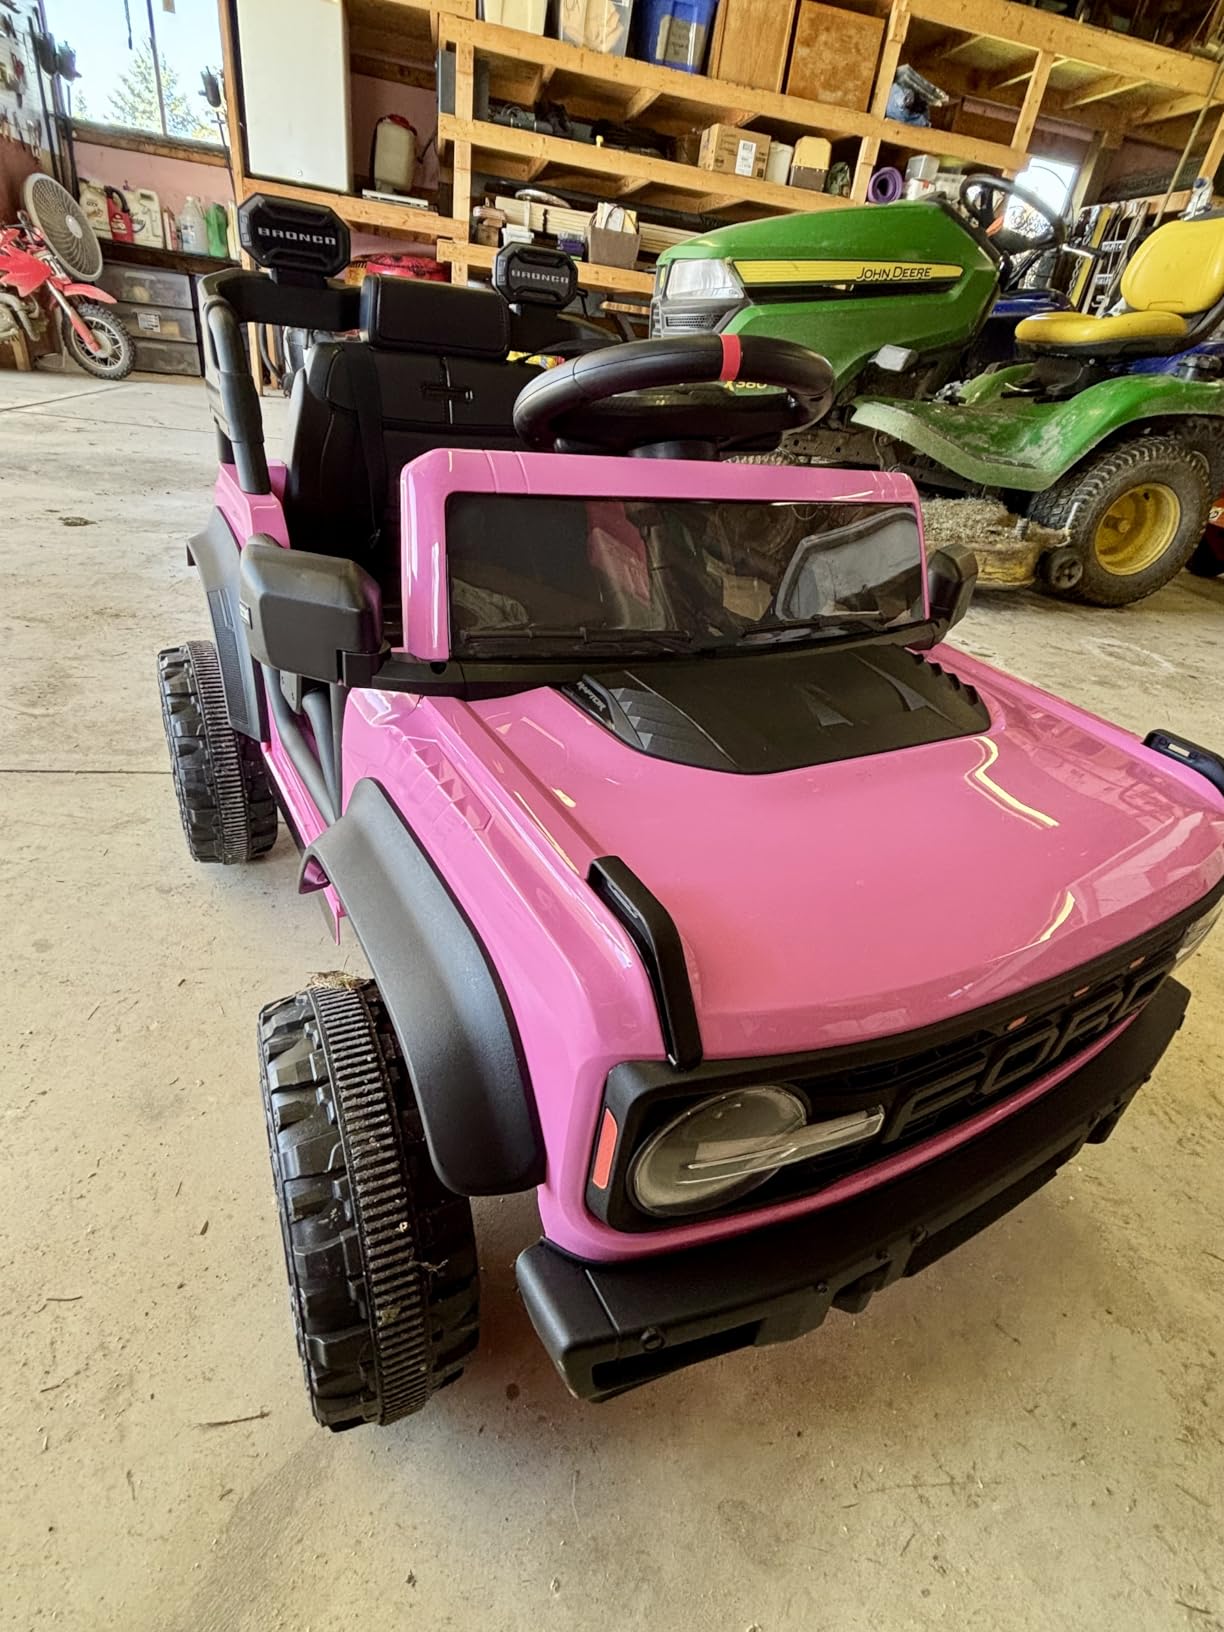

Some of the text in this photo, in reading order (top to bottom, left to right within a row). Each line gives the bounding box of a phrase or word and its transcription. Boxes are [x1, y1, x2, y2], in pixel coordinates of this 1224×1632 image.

[257, 226, 337, 246] BRONCO
[511, 269, 569, 284] BRONCO
[856, 266, 932, 280] JOHN DEERE
[577, 681, 606, 711] RAPTOR
